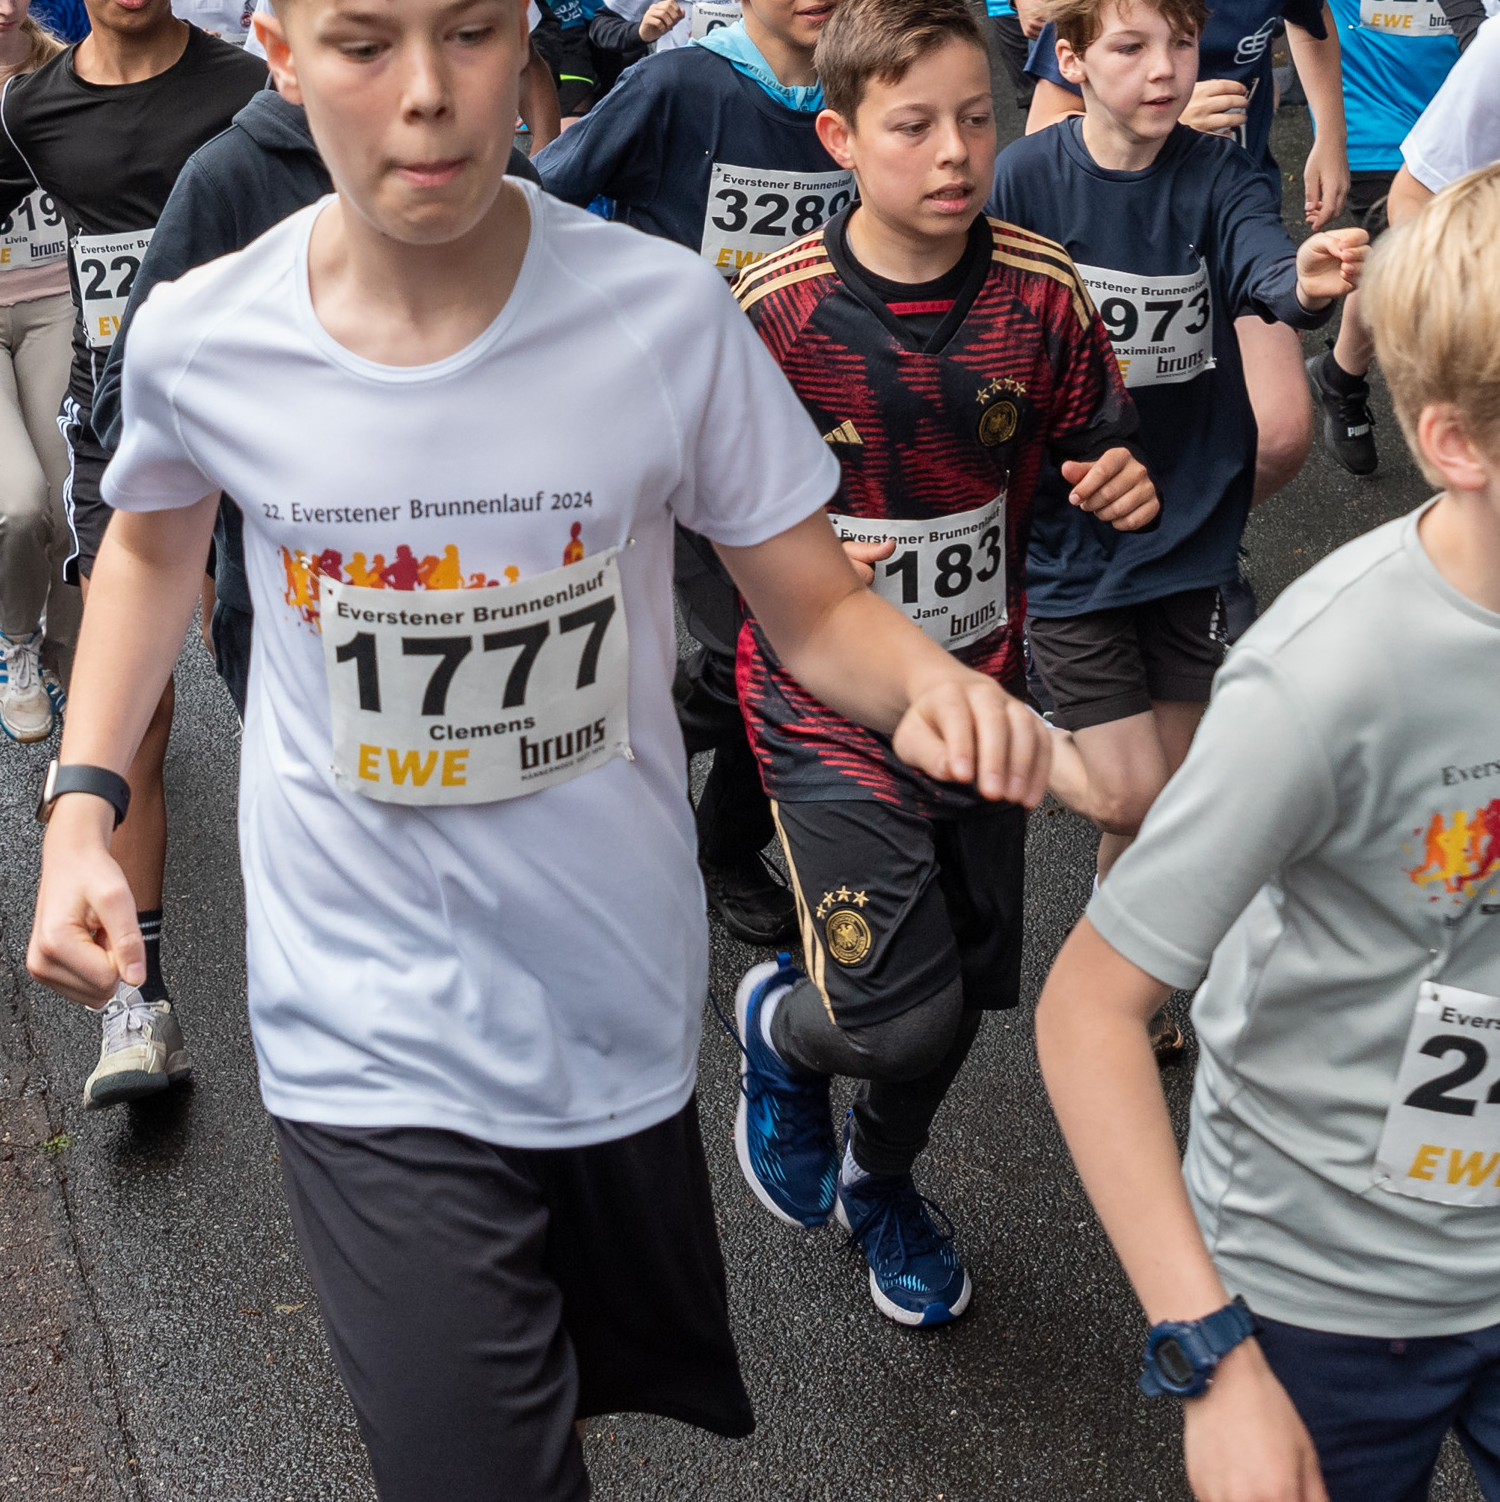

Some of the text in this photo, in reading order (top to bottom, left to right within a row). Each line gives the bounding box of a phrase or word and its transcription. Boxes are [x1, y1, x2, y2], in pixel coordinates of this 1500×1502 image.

[698, 8, 739, 19] Everstener
[1370, 12, 1414, 29] EWE
[1429, 13, 1450, 27] bru
[722, 173, 791, 190] Everstener
[4, 236, 29, 245] Livia
[30, 240, 67, 257] bruns
[80, 243, 134, 255] Everstener
[716, 247, 767, 269] EW
[80, 255, 143, 300] 22
[1082, 279, 1138, 295] erstener
[1100, 288, 1211, 343] 973
[1113, 346, 1176, 356] aximilian
[1156, 349, 1204, 374] bruns
[263, 490, 593, 523] 22. Everstener Brunnenlauf 2024
[929, 506, 1001, 543] Brunnenlauf
[884, 524, 1002, 604] 183
[336, 570, 605, 626] Everstener Brunnenlauf
[912, 605, 949, 620] Jano
[950, 600, 996, 637] bruns
[335, 594, 617, 716] 1777
[429, 716, 536, 741] Clemens
[519, 716, 606, 771] bruns
[357, 742, 470, 787] EWE
